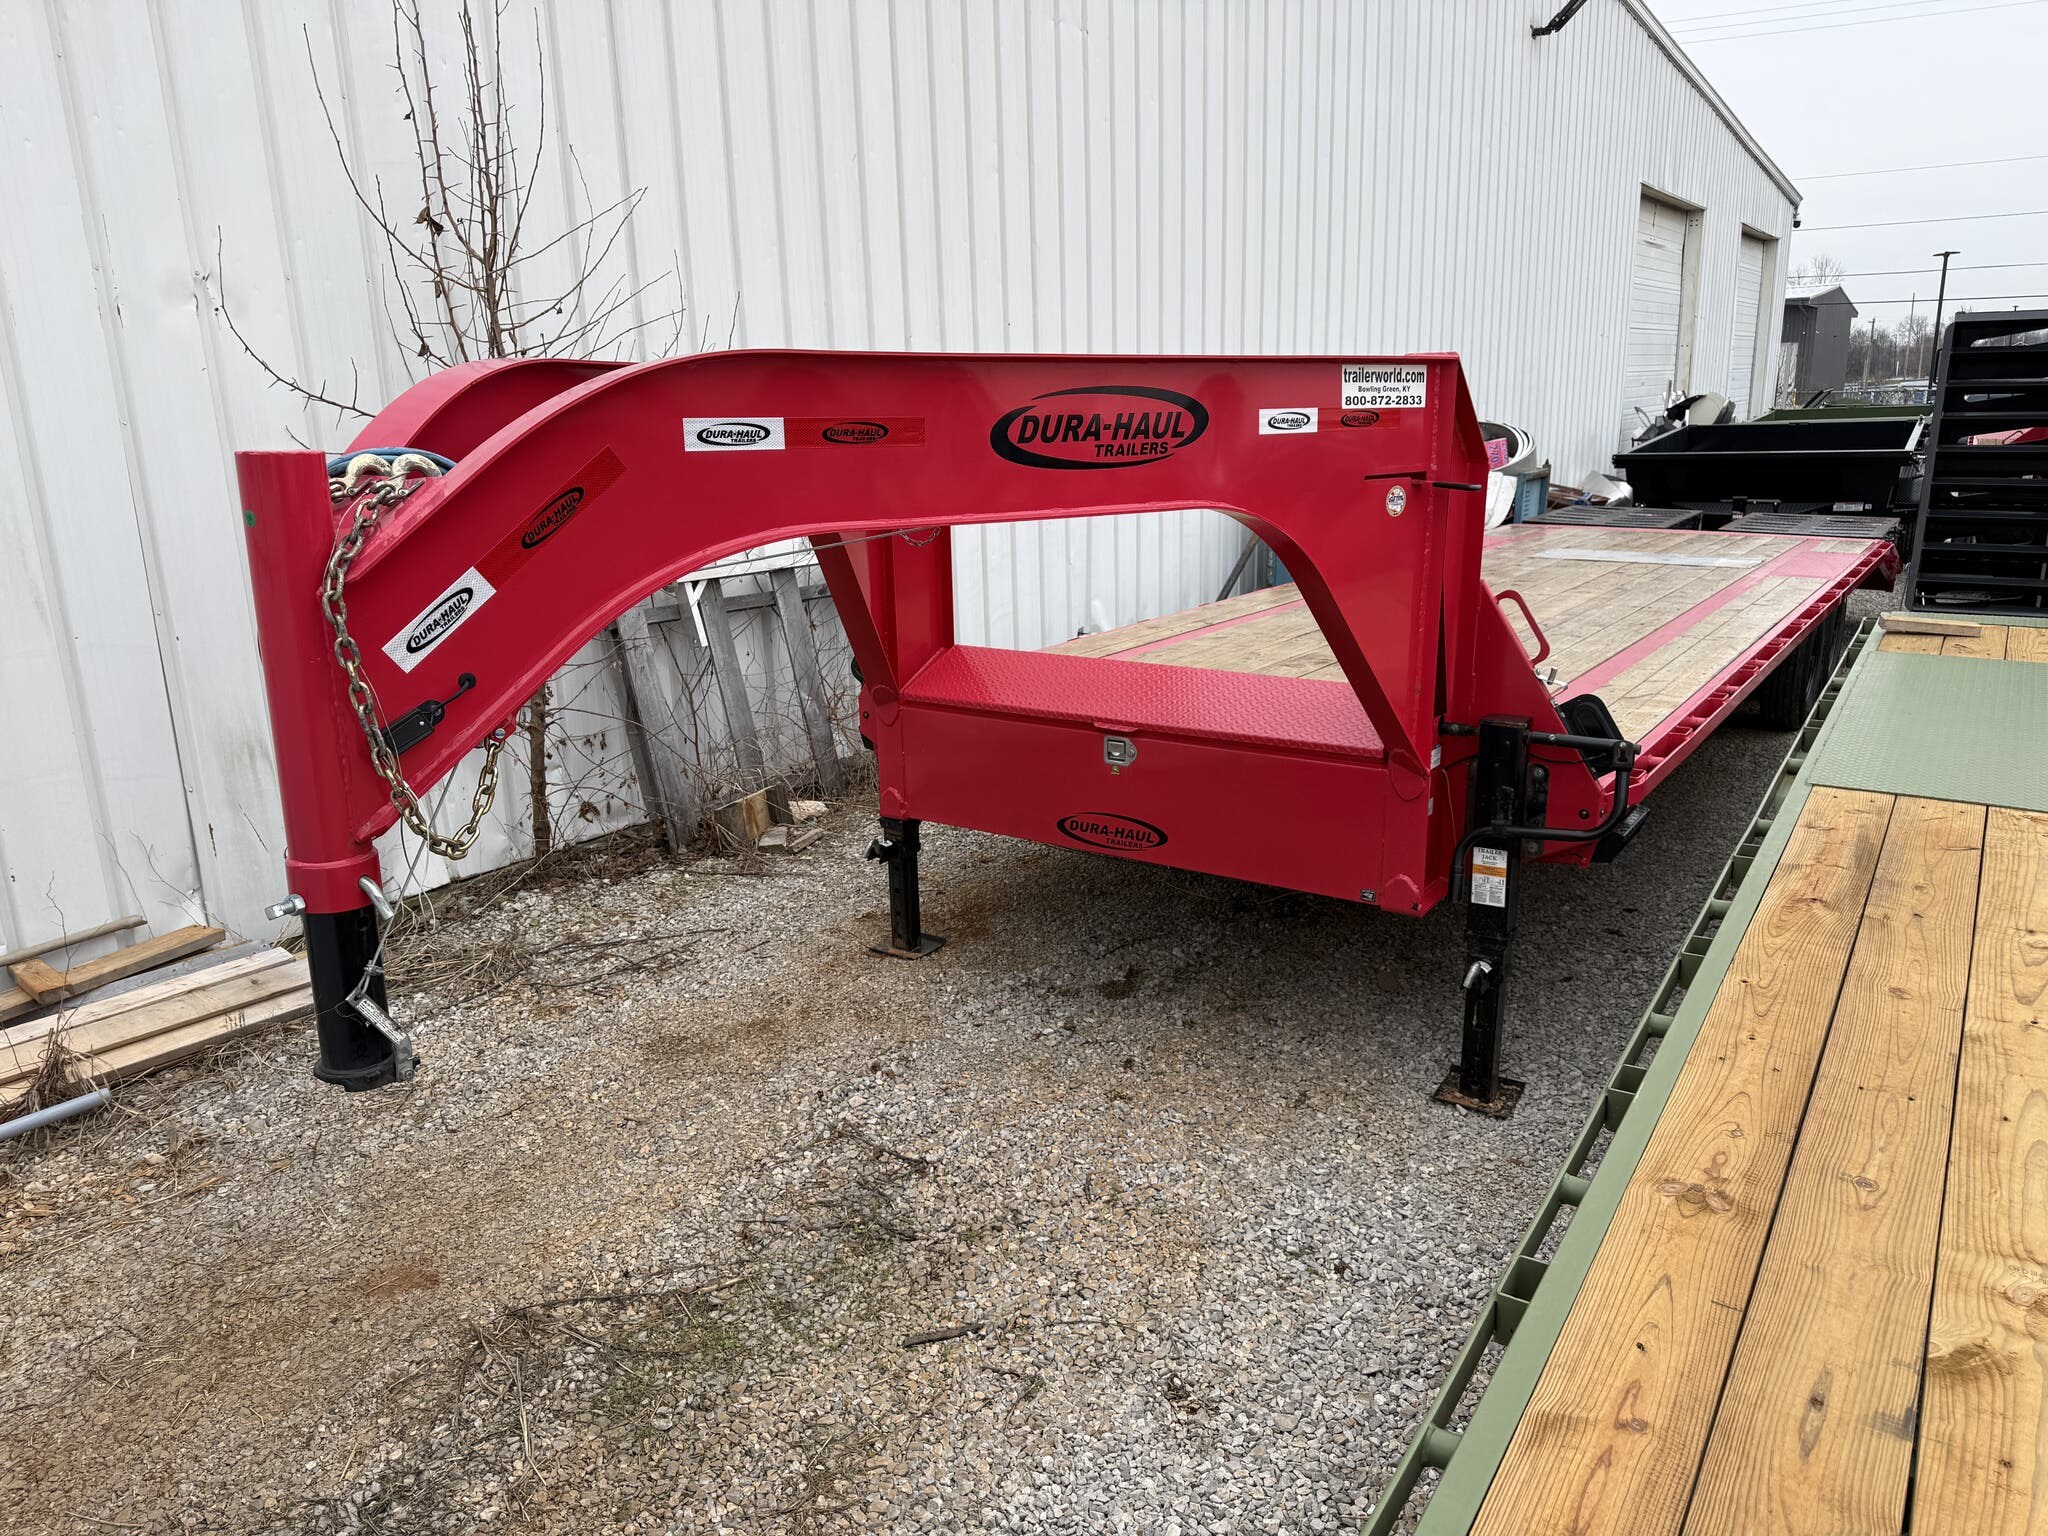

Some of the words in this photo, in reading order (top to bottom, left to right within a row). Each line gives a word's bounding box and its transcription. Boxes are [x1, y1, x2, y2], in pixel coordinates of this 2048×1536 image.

[1344, 367, 1425, 383] trailerworld.com
[1358, 385, 1381, 393] Bowling
[1383, 385, 1401, 393] Green,
[1345, 395, 1422, 406] 800-872-2833
[705, 430, 762, 439] DURA-HAUL
[829, 428, 881, 437] DURA-HAUL
[1017, 411, 1185, 444] DURA-HAUL
[1094, 442, 1168, 457] TRAILERS
[527, 494, 579, 542] DURA-HAUL
[412, 595, 468, 647] DURA-HAUL
[440, 606, 466, 629] TRAILERS
[1069, 820, 1155, 843] DURA-HAUL
[1106, 838, 1143, 849] TRAILERS
